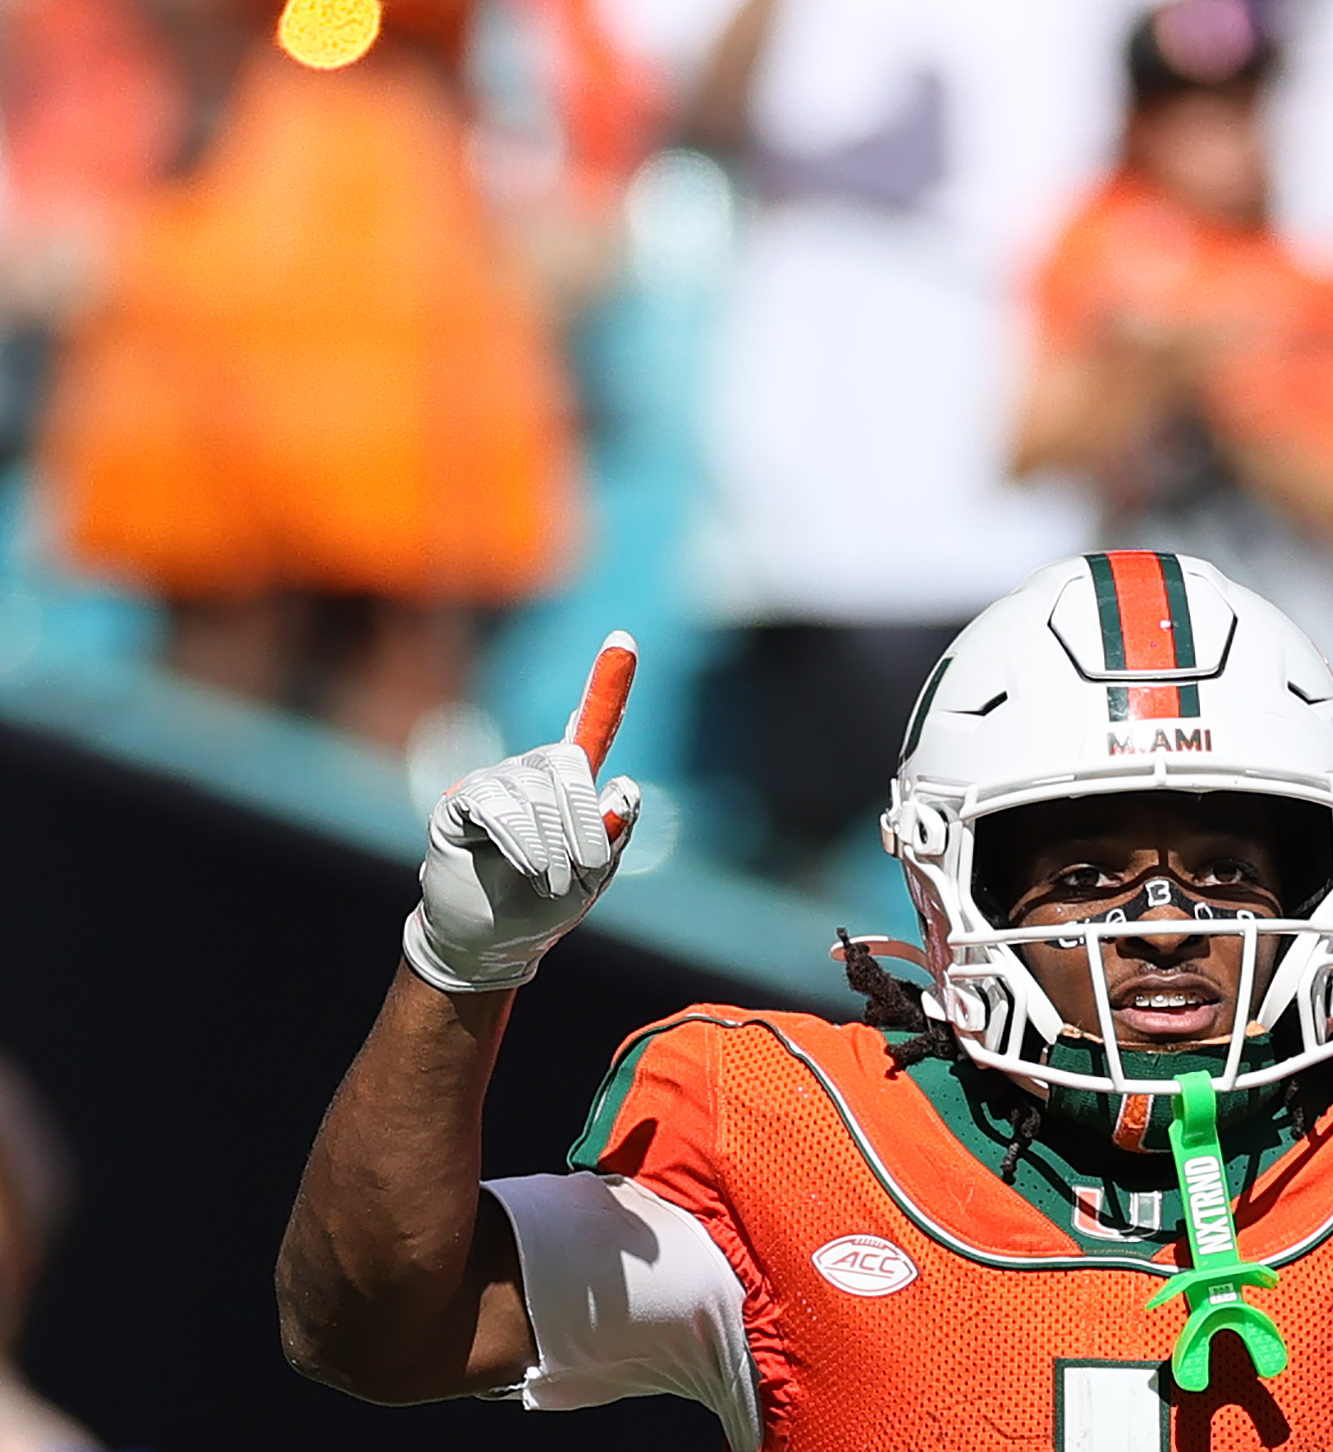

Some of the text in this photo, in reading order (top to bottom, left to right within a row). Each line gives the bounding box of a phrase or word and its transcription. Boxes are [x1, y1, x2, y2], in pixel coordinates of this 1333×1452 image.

[1107, 729, 1212, 756] MAMI
[1184, 1156, 1234, 1255] NXTRND
[832, 1251, 900, 1274] ACC
